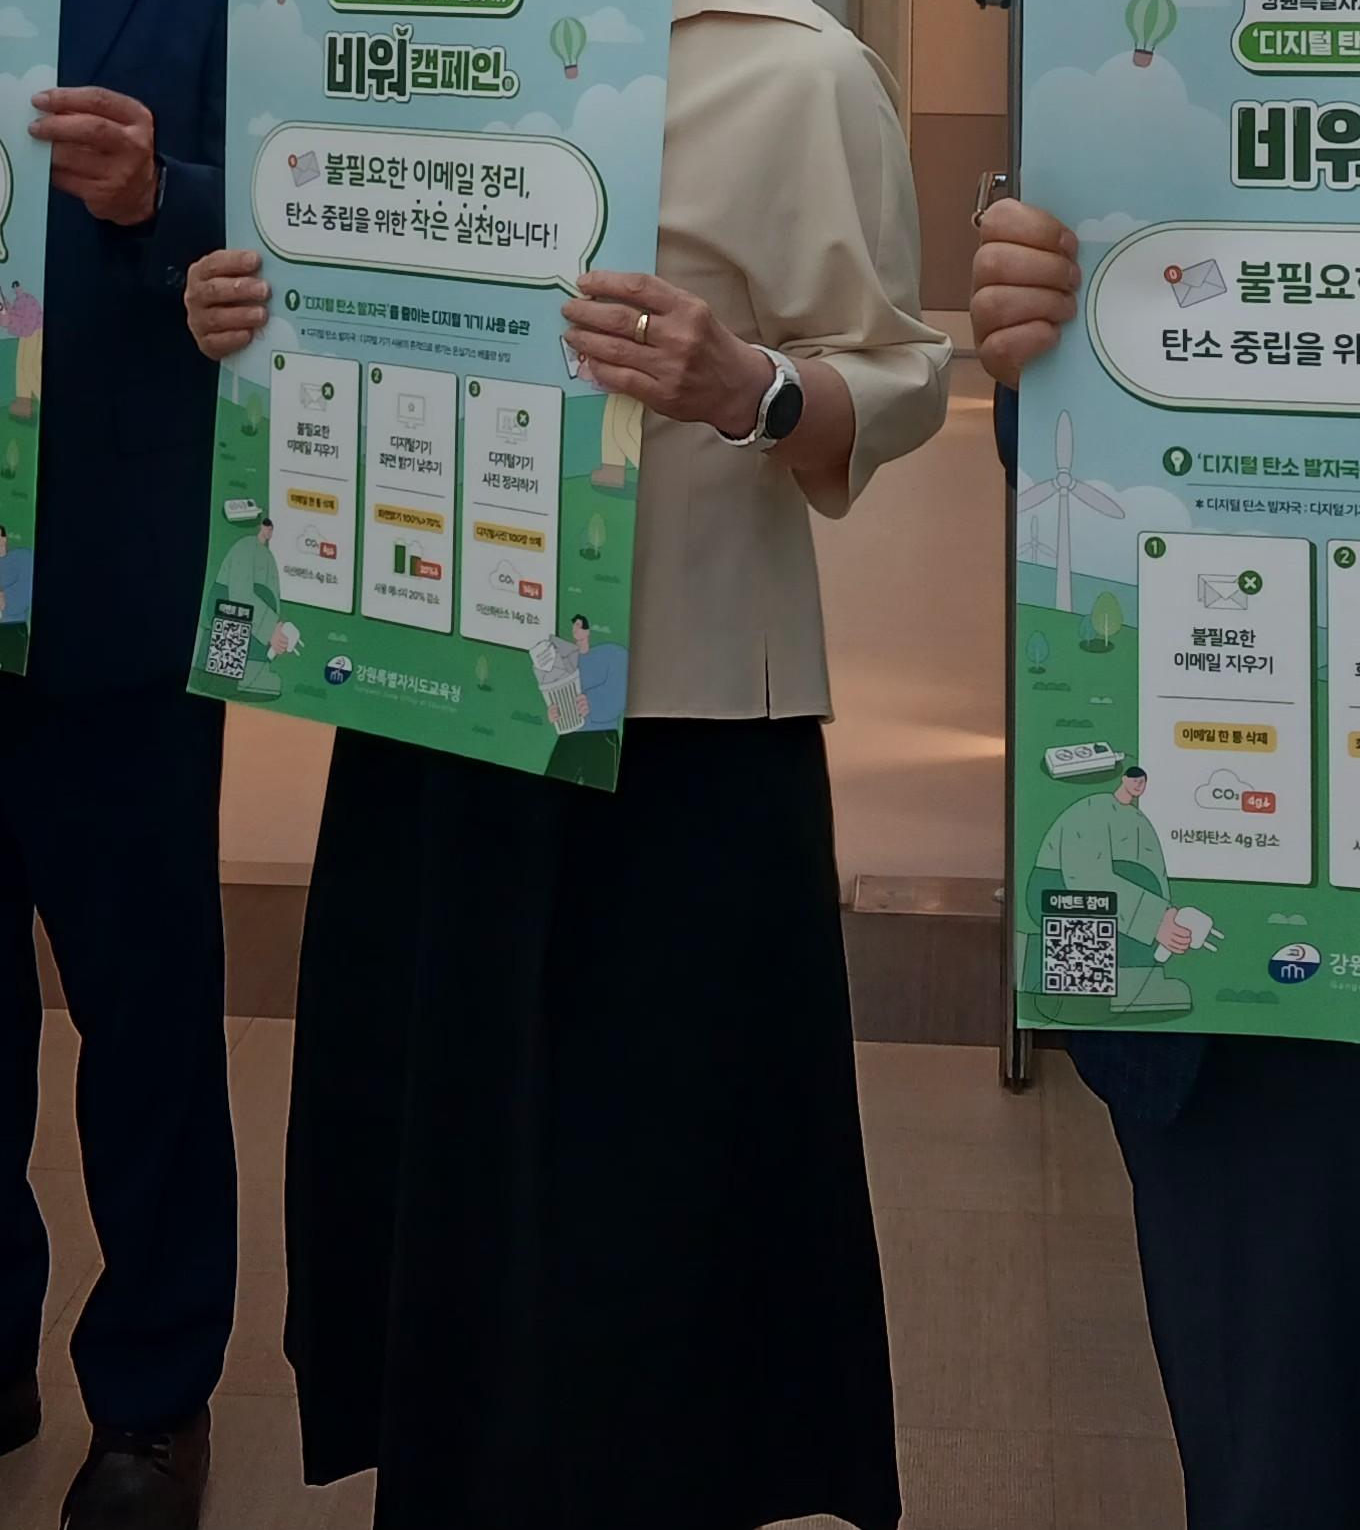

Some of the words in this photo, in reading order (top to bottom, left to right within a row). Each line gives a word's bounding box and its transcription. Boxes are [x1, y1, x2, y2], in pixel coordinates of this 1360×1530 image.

[1252, 28, 1332, 56] ‘디지털
[324, 153, 408, 190] 불필요한
[413, 159, 474, 196] 이메일
[480, 164, 530, 199] 정리,
[286, 202, 318, 228] 탄소
[321, 204, 371, 234] 중립을
[374, 208, 407, 237] 위한
[410, 208, 450, 241] 작은
[454, 212, 558, 250] 실천입니다!
[1162, 328, 1223, 362] 탄소
[1230, 330, 1324, 367] 중립을
[1262, 457, 1300, 477] 탄소
[1206, 497, 1240, 511] 디지털
[1243, 500, 1265, 513] 탄소
[1310, 502, 1344, 516] 디지털
[1191, 627, 1256, 648] 불필요한
[1174, 652, 1221, 672] 이메일
[1225, 655, 1273, 674] 지우기
[1182, 728, 1215, 742] 이메일
[1218, 729, 1229, 743] 한
[1171, 829, 1232, 845] 이산화탄소
[1235, 833, 1252, 848] 4g
[1255, 833, 1280, 847] 감소
